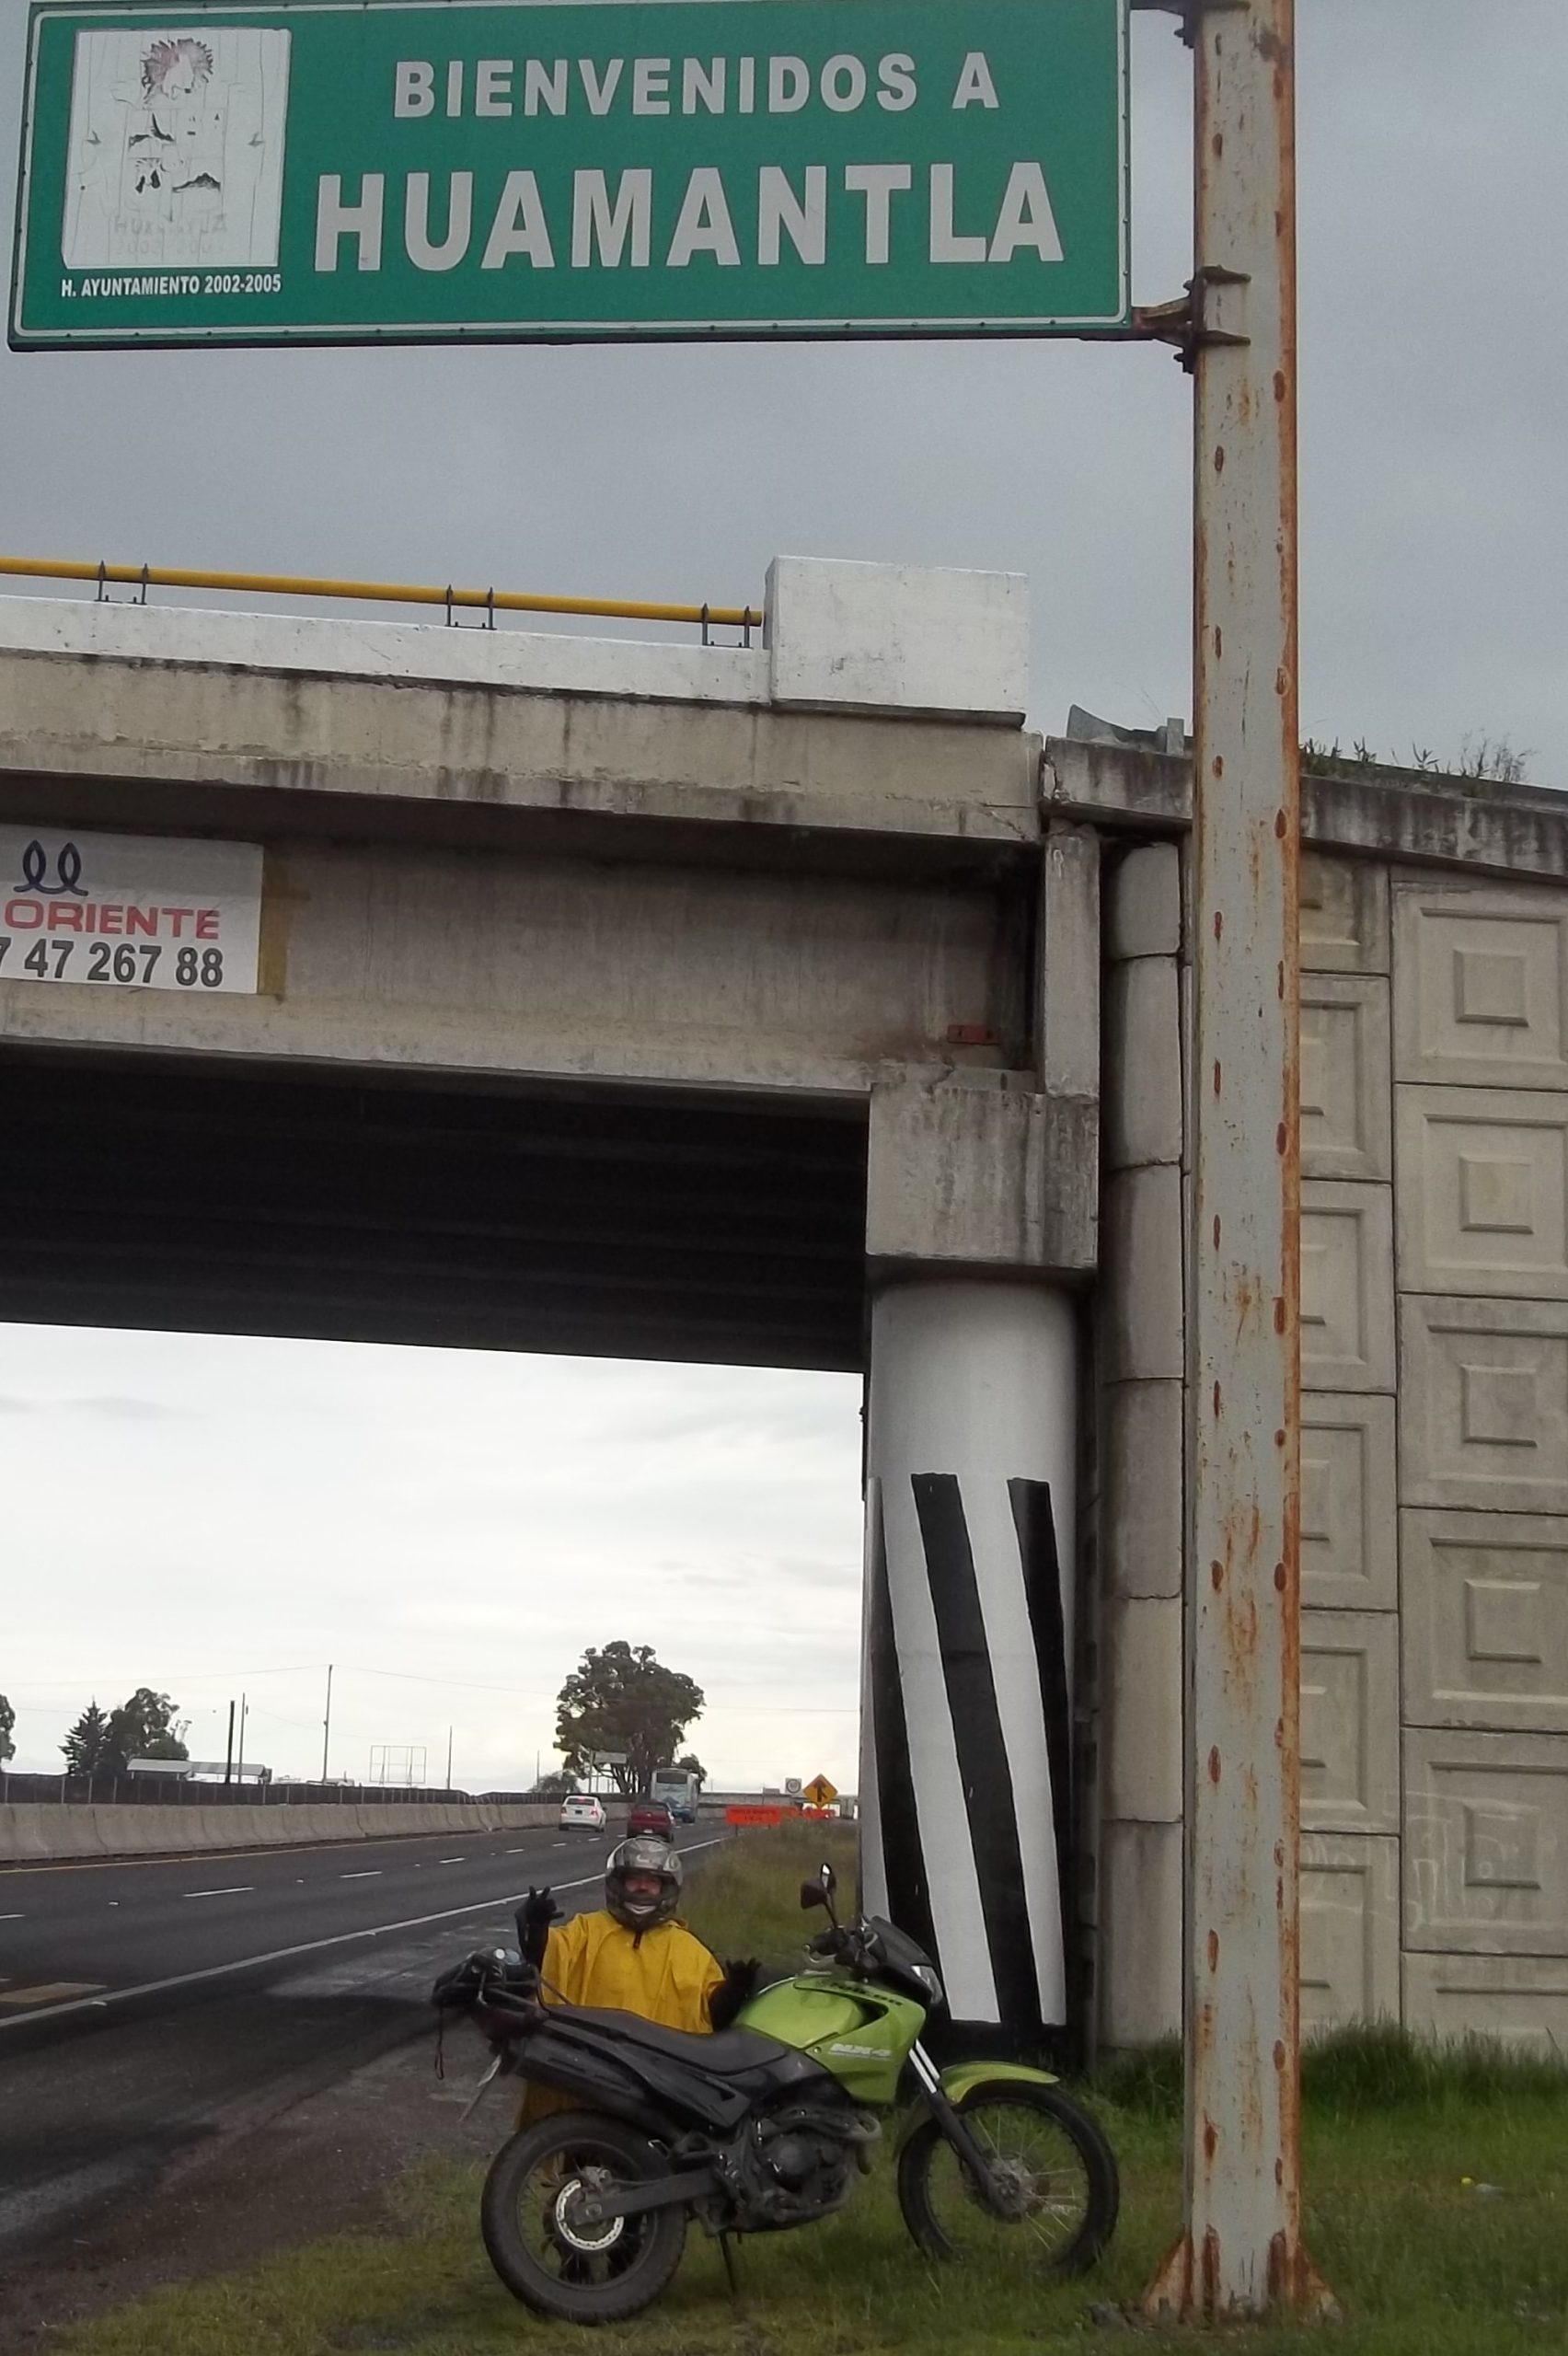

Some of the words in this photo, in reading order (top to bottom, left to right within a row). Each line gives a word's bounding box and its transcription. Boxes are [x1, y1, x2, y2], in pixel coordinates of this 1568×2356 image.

[394, 53, 917, 118] BIENVENIDOS
[951, 52, 999, 109] A
[315, 162, 1065, 271] HUAMANTLA
[61, 279, 76, 297] H.
[81, 275, 201, 296] AYUNTAMIENTO
[204, 274, 282, 294] 2002-2005
[5, 898, 220, 940] ORIENTE
[24, 938, 75, 978] 47
[87, 941, 162, 984] 267
[175, 947, 224, 987] 88
